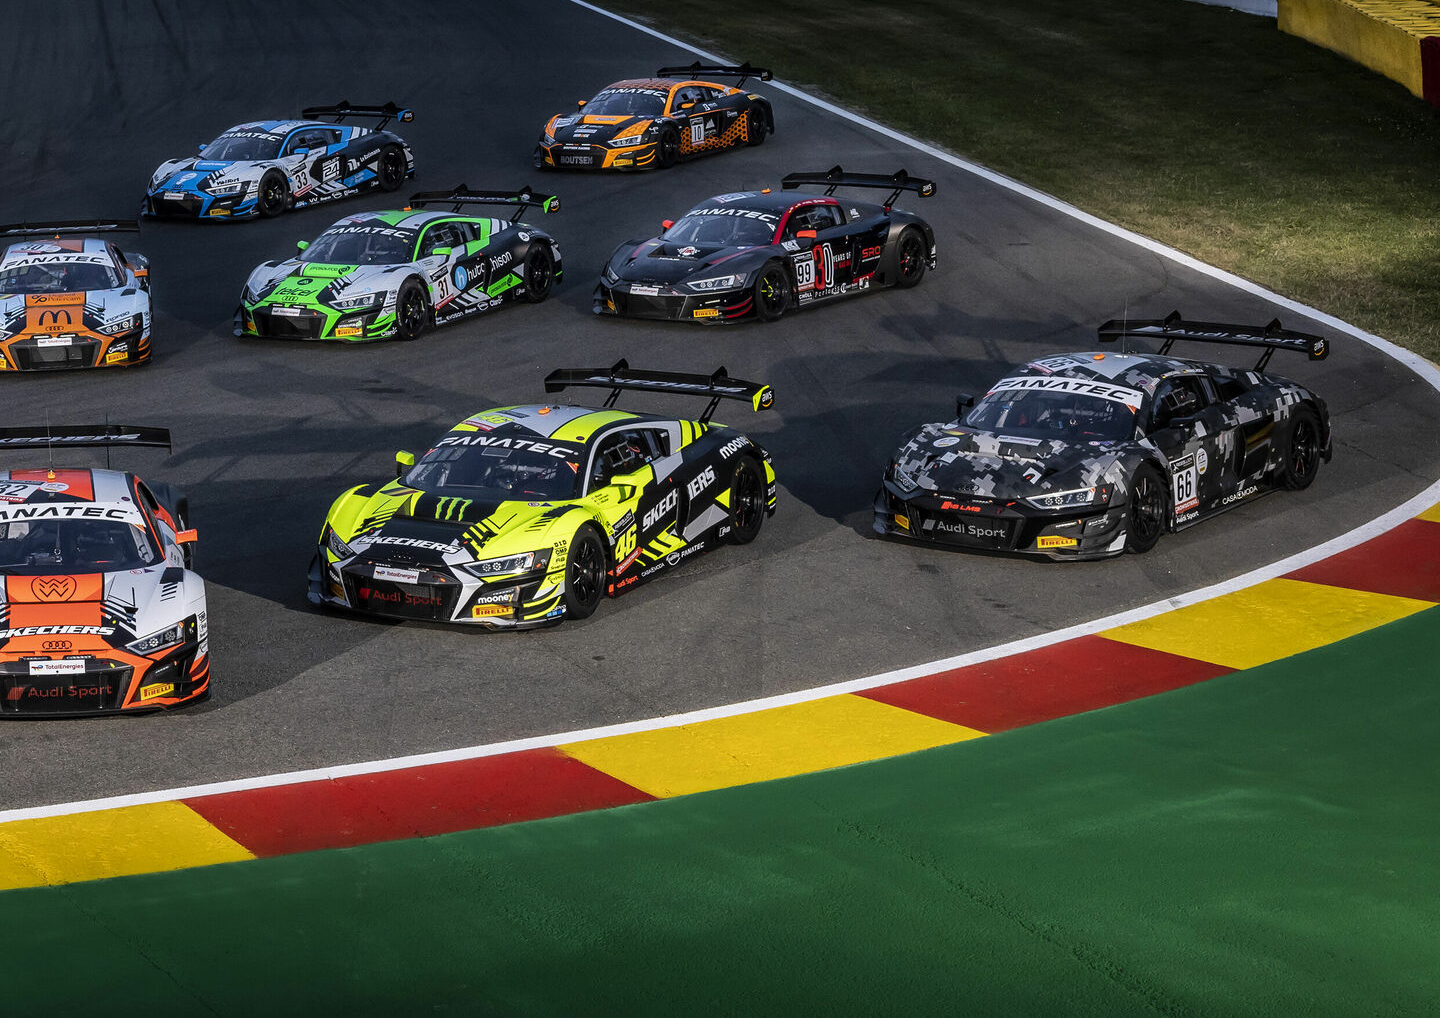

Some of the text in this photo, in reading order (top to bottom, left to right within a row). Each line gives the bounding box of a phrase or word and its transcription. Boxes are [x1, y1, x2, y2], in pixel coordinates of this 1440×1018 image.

[598, 87, 666, 97] FANATEC
[220, 131, 284, 142] FANATEC
[693, 124, 703, 141] 10
[560, 155, 593, 165] BOUTSEN
[295, 171, 308, 189] 33
[686, 209, 774, 223] FANATEC
[323, 226, 412, 238] FANATEC
[861, 245, 881, 258] SRO
[4, 255, 105, 269] FANATEC
[797, 263, 812, 284] 99
[438, 278, 450, 299] 31
[338, 328, 362, 336] PIRELLI
[1172, 329, 1308, 346] Audi Sport
[108, 352, 127, 361] PIRELLI
[762, 390, 773, 400] aws
[993, 380, 1128, 400] FANATEC
[436, 435, 574, 458] FANATEC
[1177, 471, 1192, 503] 66
[960, 504, 981, 513] LMS
[1176, 511, 1199, 524] Audi Sport
[936, 521, 1006, 539] Audi Sport
[357, 534, 462, 554] SKECHERS
[615, 523, 637, 562] 46
[1040, 537, 1077, 547] PIRELLI
[555, 548, 567, 556] OMP
[680, 541, 705, 558] FANATEC
[386, 570, 417, 582] TotalEnergies
[626, 574, 639, 586] Sport
[373, 588, 443, 606] Audi Sport
[478, 592, 513, 605] mooney
[475, 606, 511, 616] PIRELLI
[44, 662, 84, 671] TotalEnergies
[28, 684, 112, 701] Audi Sport
[142, 683, 173, 698] PIRELLI
